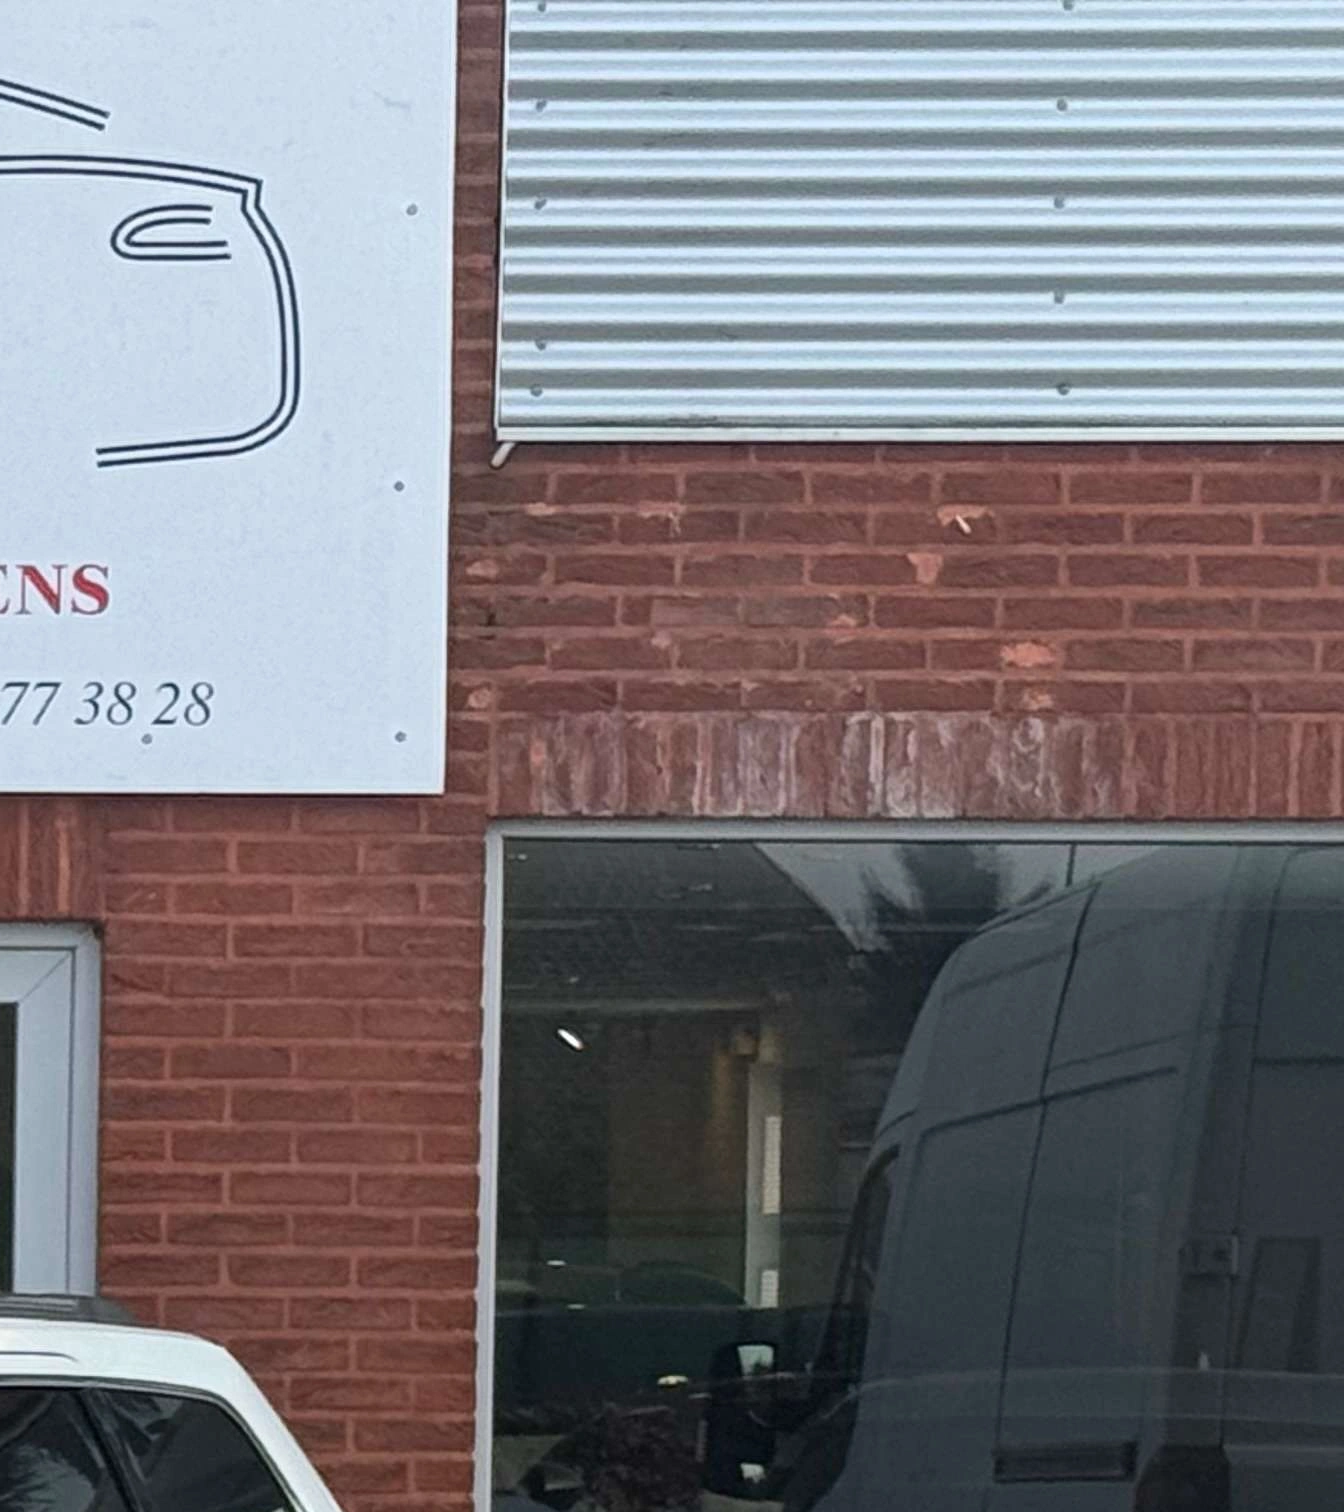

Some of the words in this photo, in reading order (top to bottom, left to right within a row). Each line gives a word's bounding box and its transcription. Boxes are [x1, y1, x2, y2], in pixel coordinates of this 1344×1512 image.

[1, 681, 62, 726] 77
[74, 681, 137, 726] 38
[151, 681, 214, 726] 28
